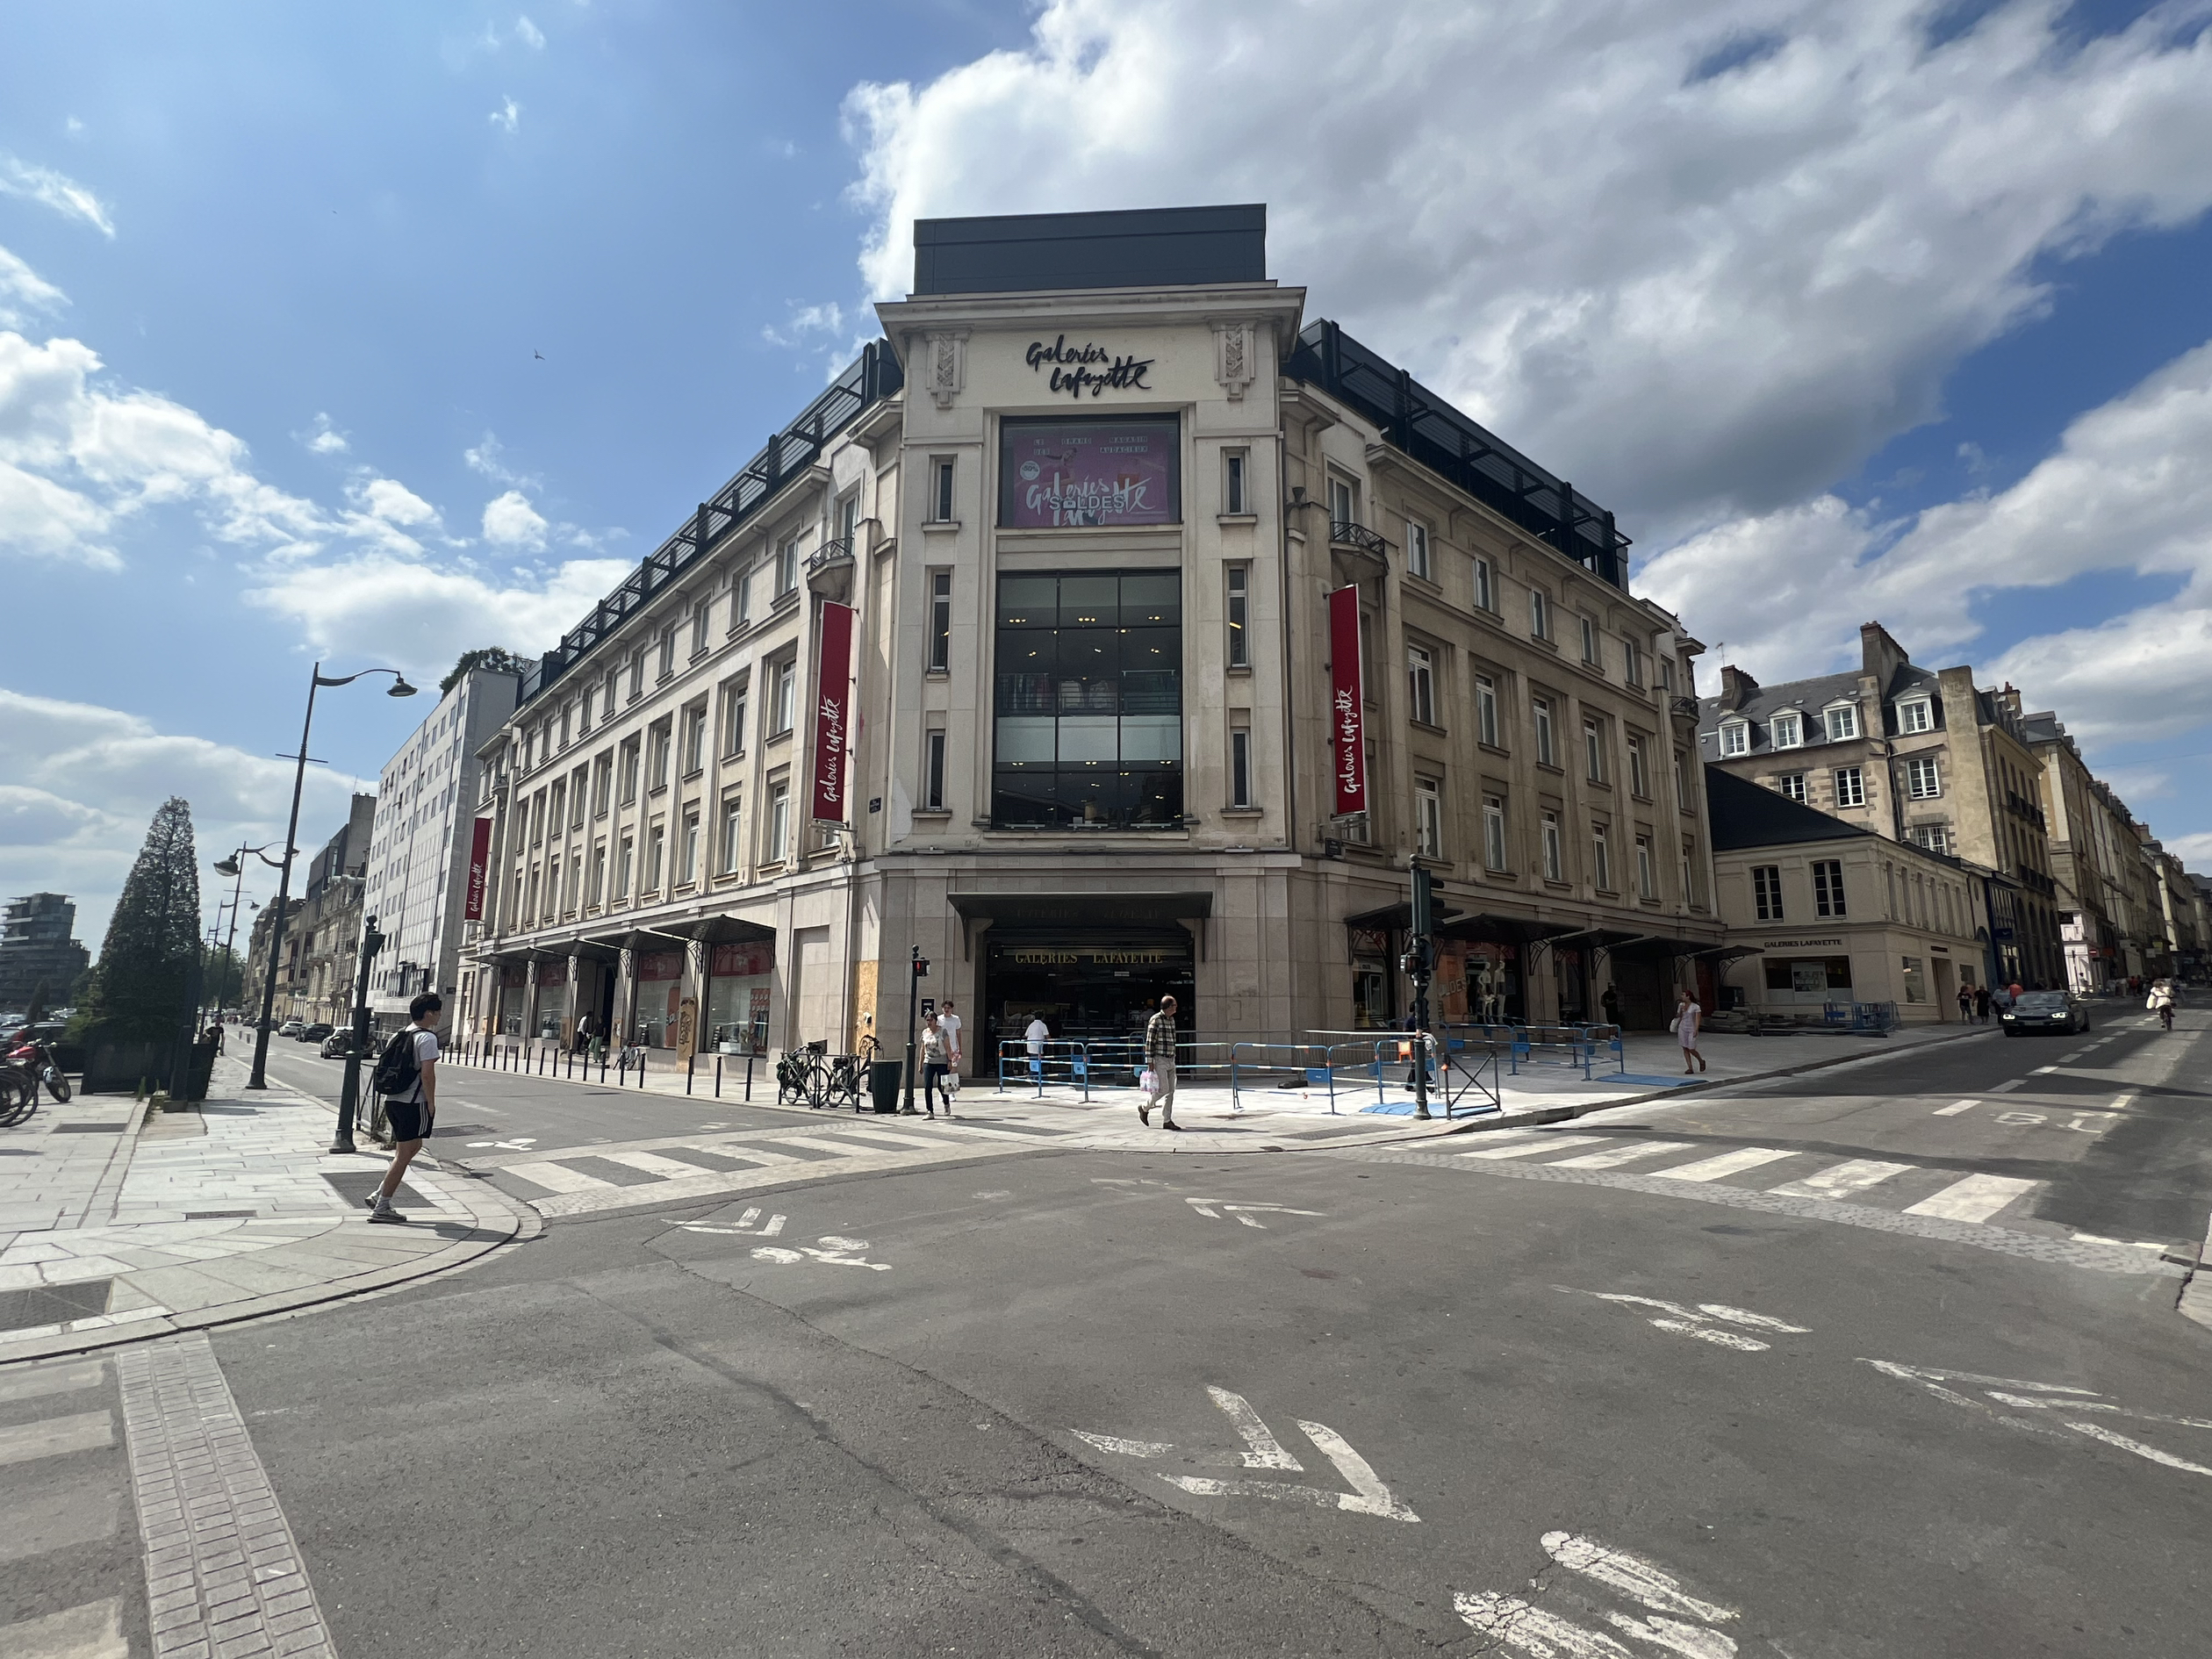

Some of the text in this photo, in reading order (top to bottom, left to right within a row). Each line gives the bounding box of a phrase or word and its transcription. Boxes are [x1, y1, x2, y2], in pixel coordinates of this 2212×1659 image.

[1025, 334, 1109, 371] Galeries
[1050, 355, 1155, 398] Lafayette
[819, 693, 843, 802] Galeries Lafayette
[1334, 685, 1361, 794] Galeries Lafayette
[1015, 952, 1164, 965] GALERIES LAFAYETTE
